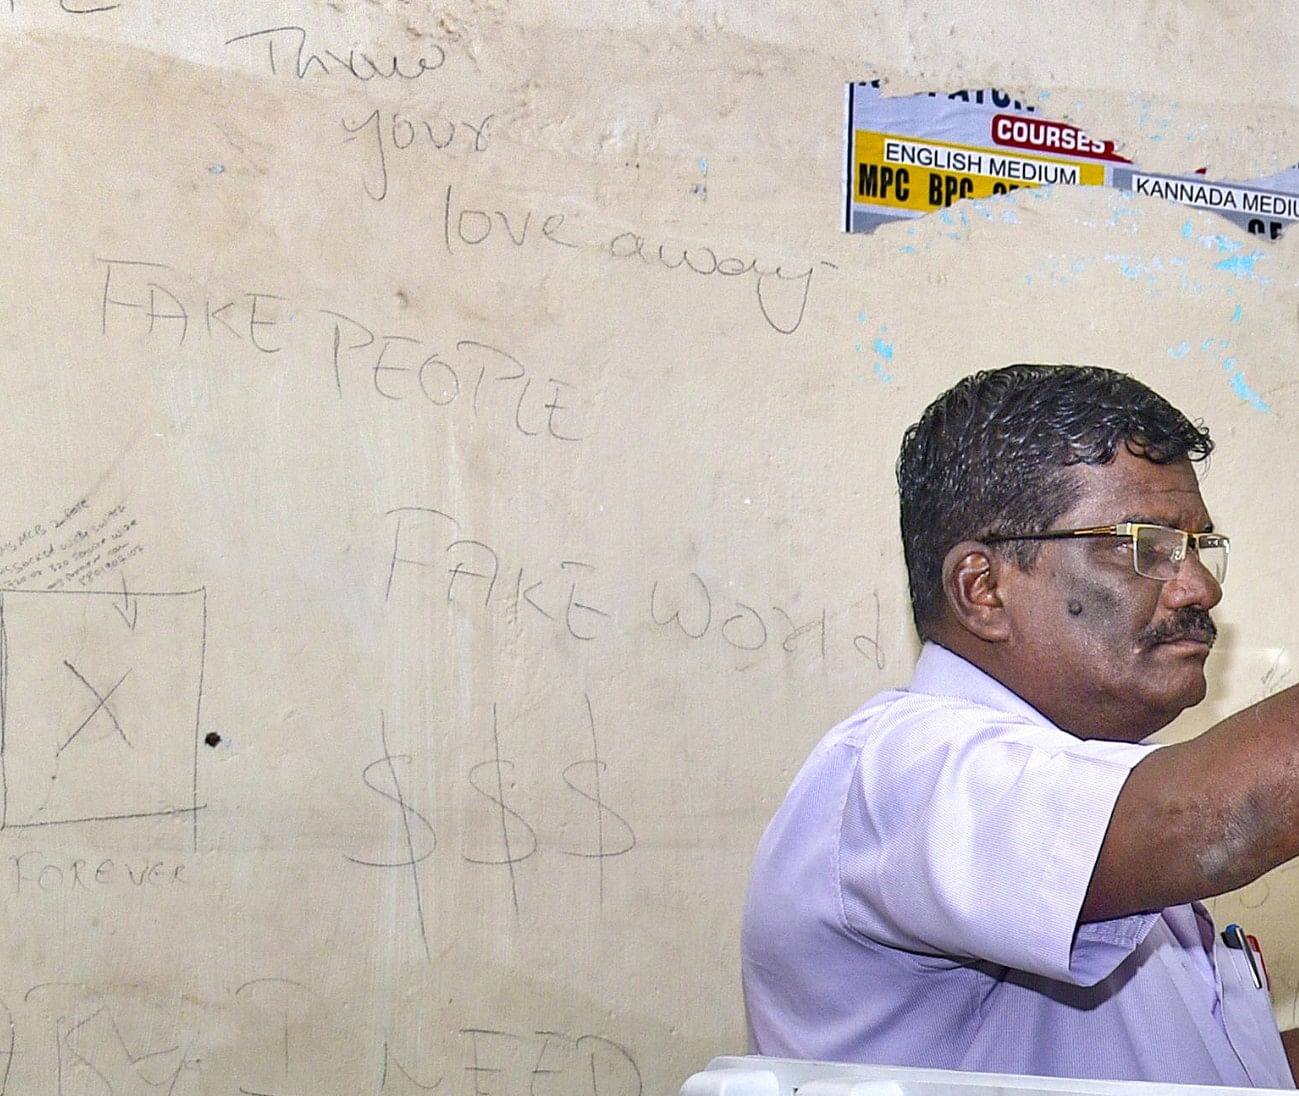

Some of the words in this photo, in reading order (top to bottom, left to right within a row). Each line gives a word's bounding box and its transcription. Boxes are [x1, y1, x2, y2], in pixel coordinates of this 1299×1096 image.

[859, 163, 909, 202] MPC
[886, 143, 982, 173] ENGLISH
[989, 159, 1077, 185] MEDIUM
[446, 185, 578, 255] love
[1137, 178, 1237, 209] KANNADA
[97, 259, 285, 353] FAKE
[319, 310, 583, 441] PEOPLE
[385, 507, 608, 641] FAKE
